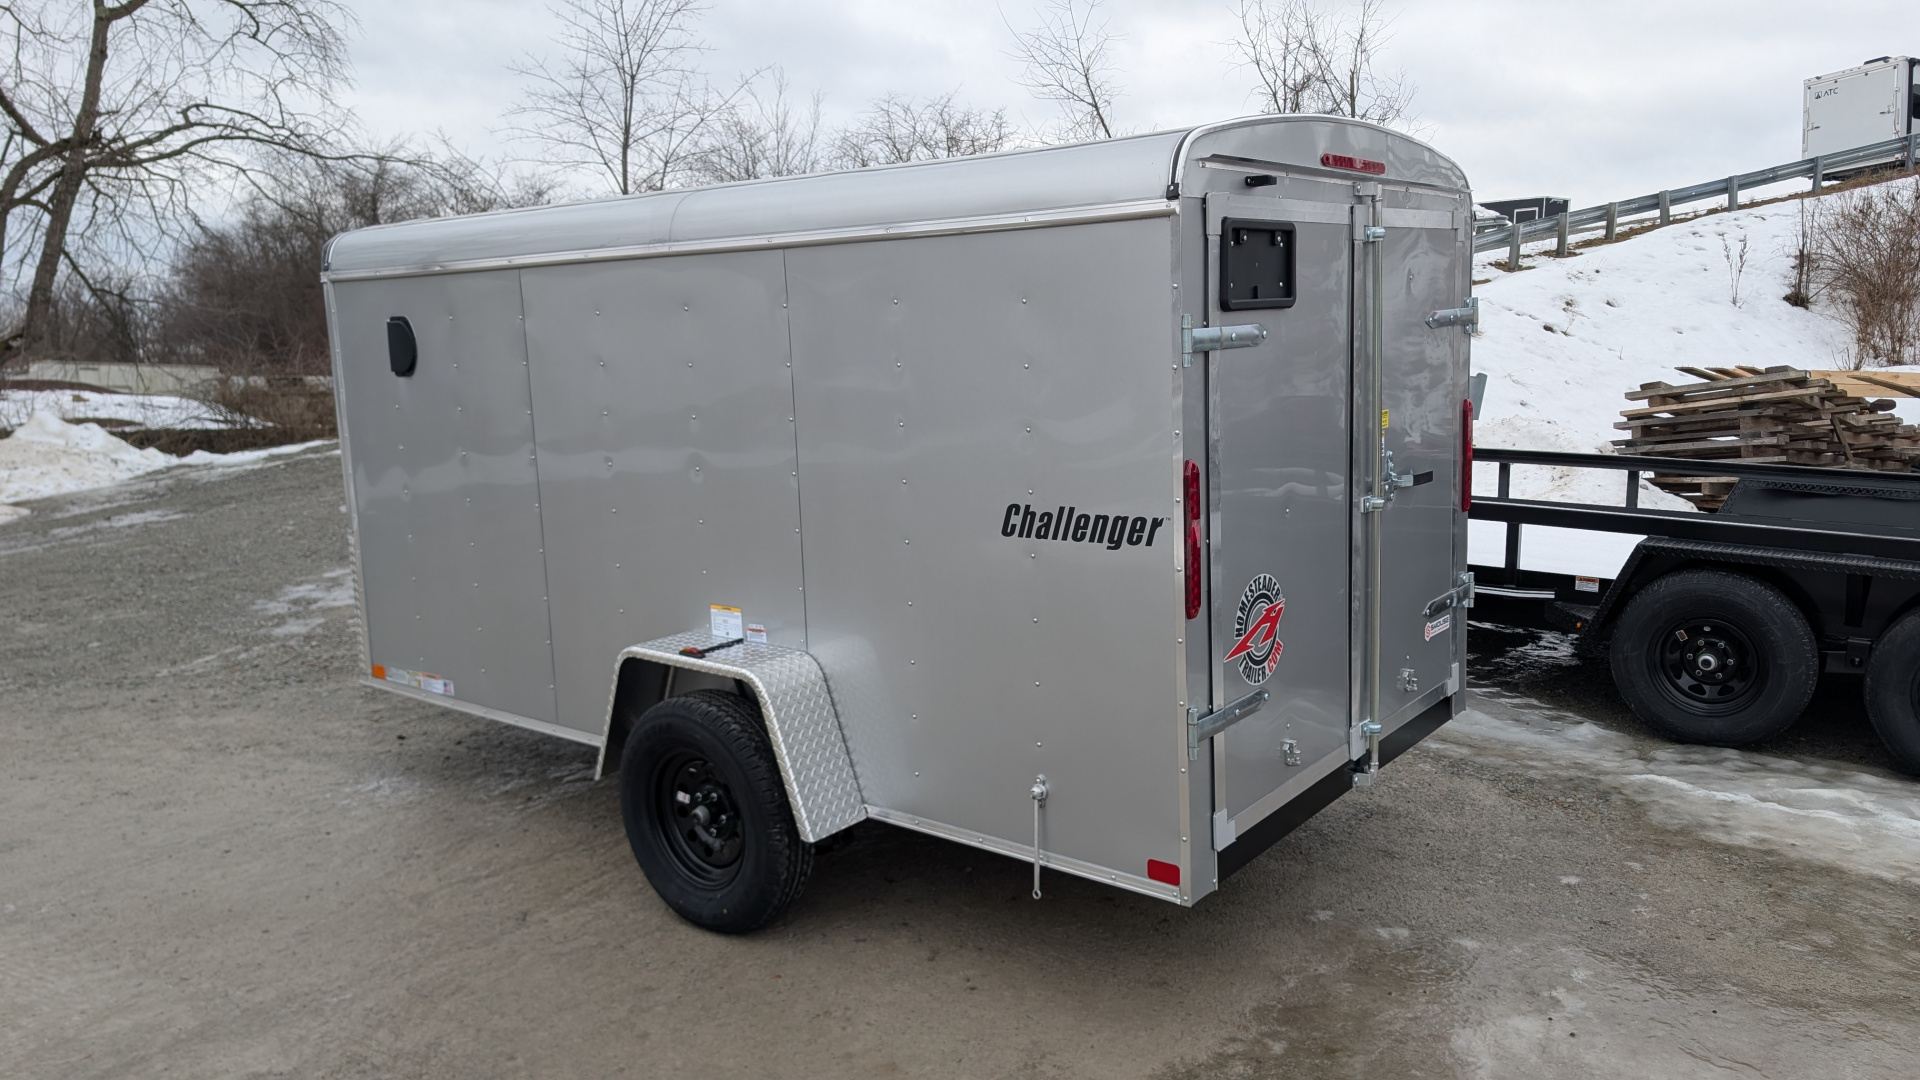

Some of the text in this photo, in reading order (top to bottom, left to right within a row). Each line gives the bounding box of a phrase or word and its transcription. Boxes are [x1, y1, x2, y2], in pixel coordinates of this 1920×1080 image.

[1823, 87, 1838, 97] ATC
[1001, 503, 1164, 551] Challenger
[1235, 574, 1281, 638] HOMESTEADER
[1239, 640, 1284, 684] TRAILER.COM
